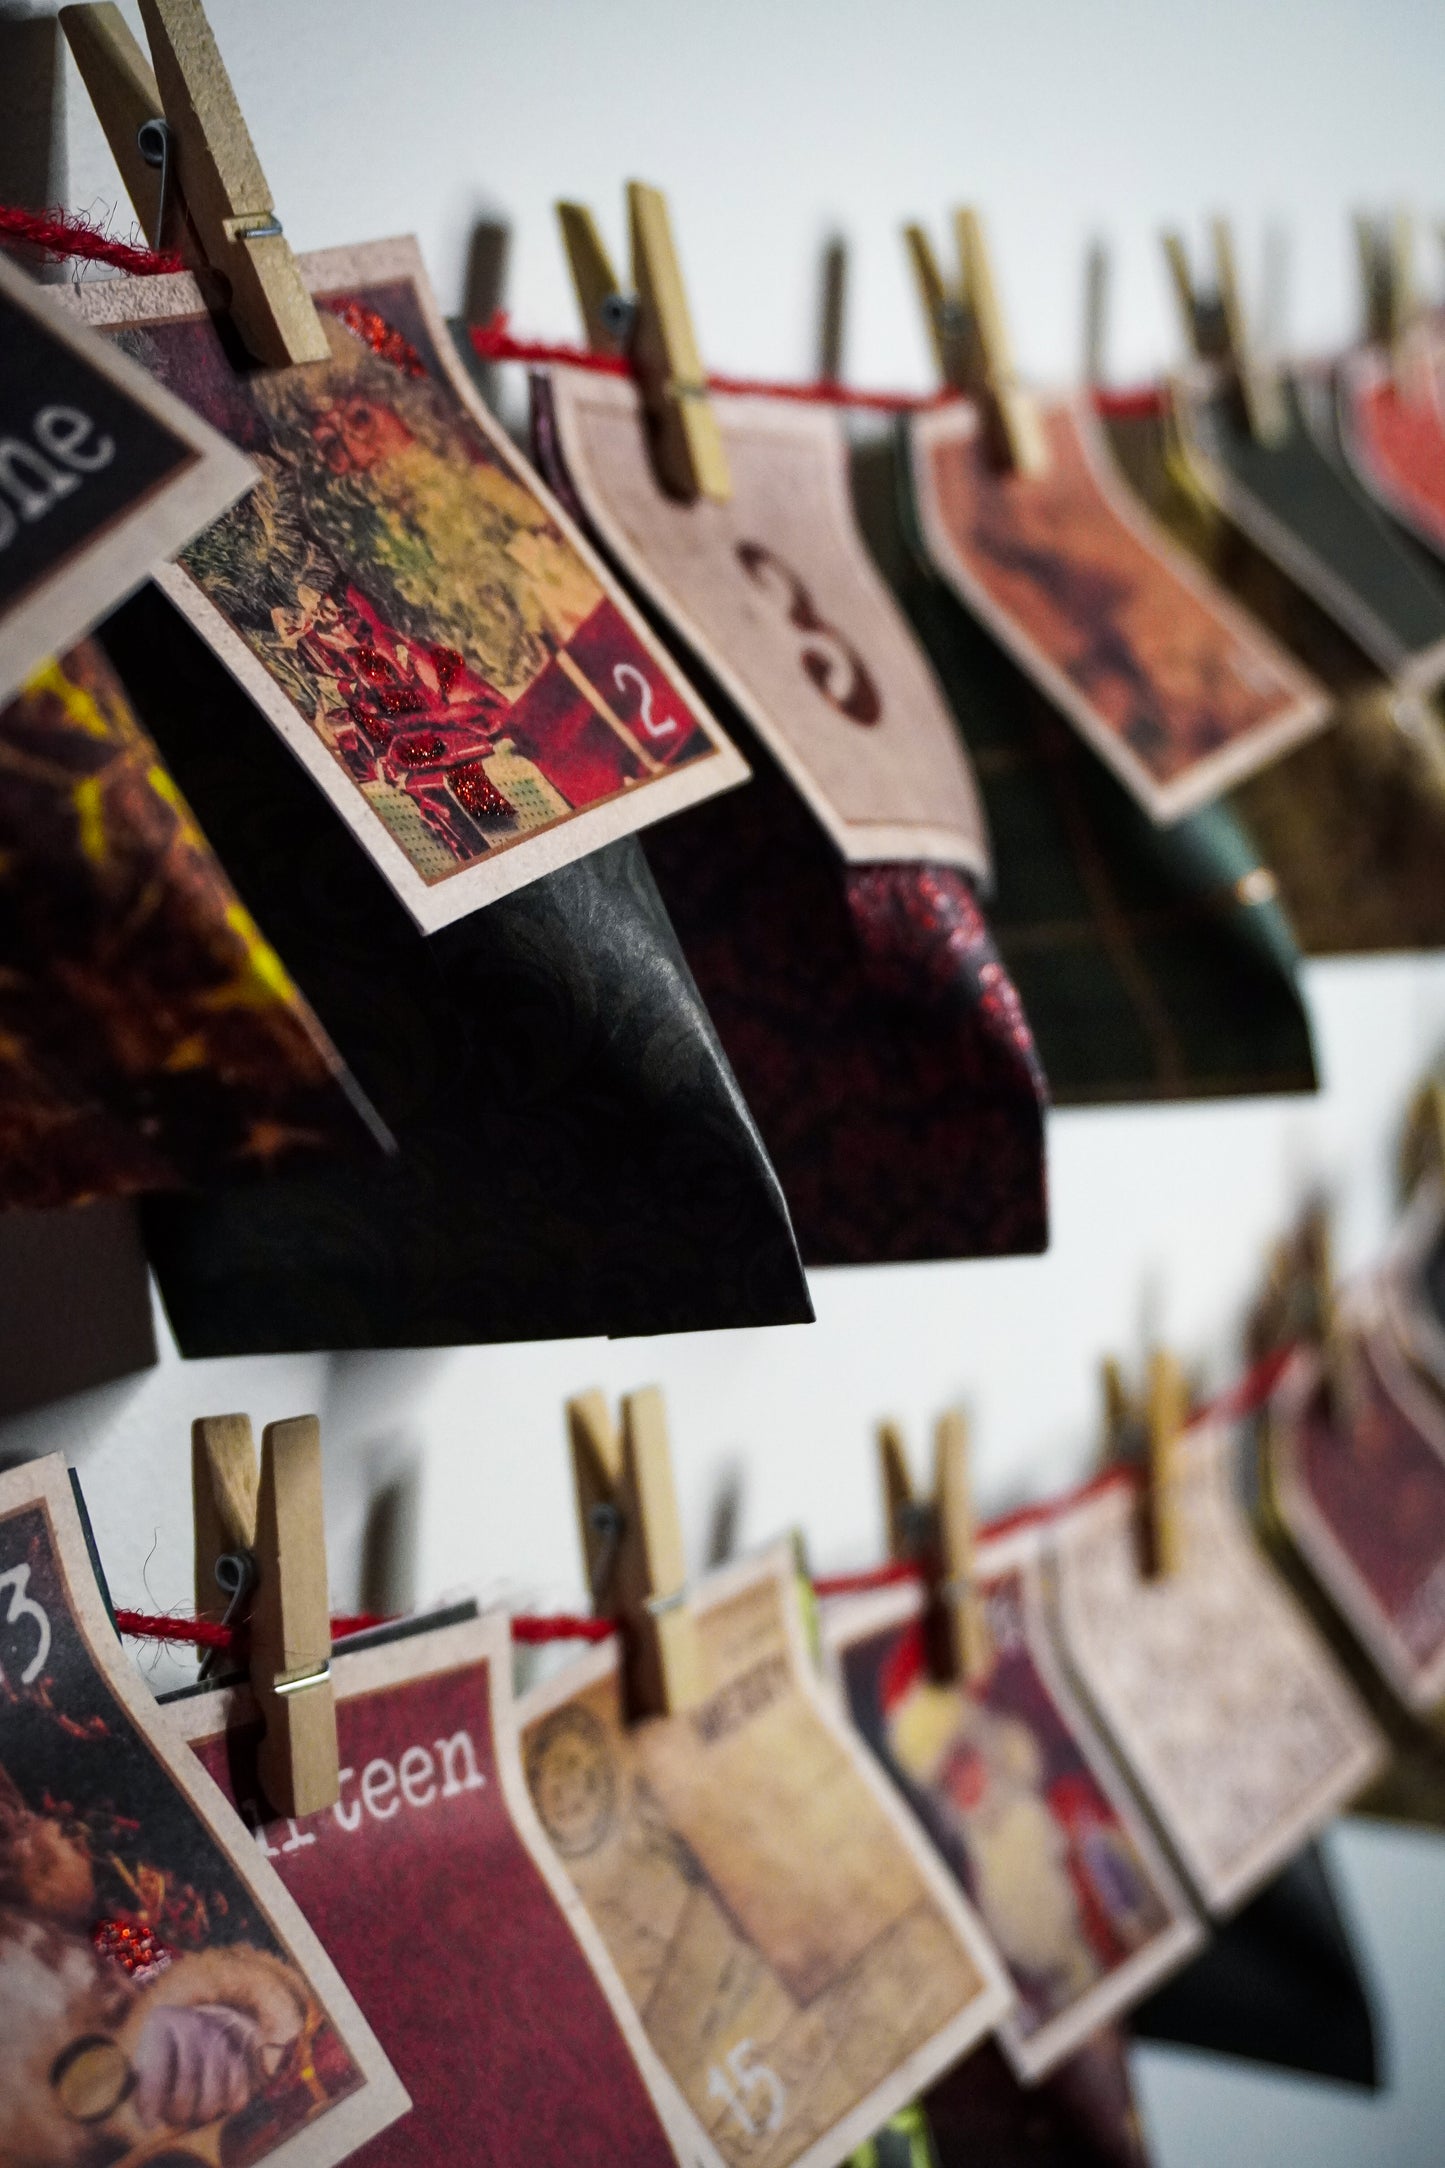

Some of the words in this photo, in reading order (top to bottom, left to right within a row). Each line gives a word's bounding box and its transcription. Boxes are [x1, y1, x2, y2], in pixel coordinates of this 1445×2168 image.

[0, 404, 117, 551] ne
[736, 537, 883, 729] 3
[613, 663, 678, 738] 2
[255, 1730, 487, 1858] teen
[706, 2036, 785, 2138] 15
